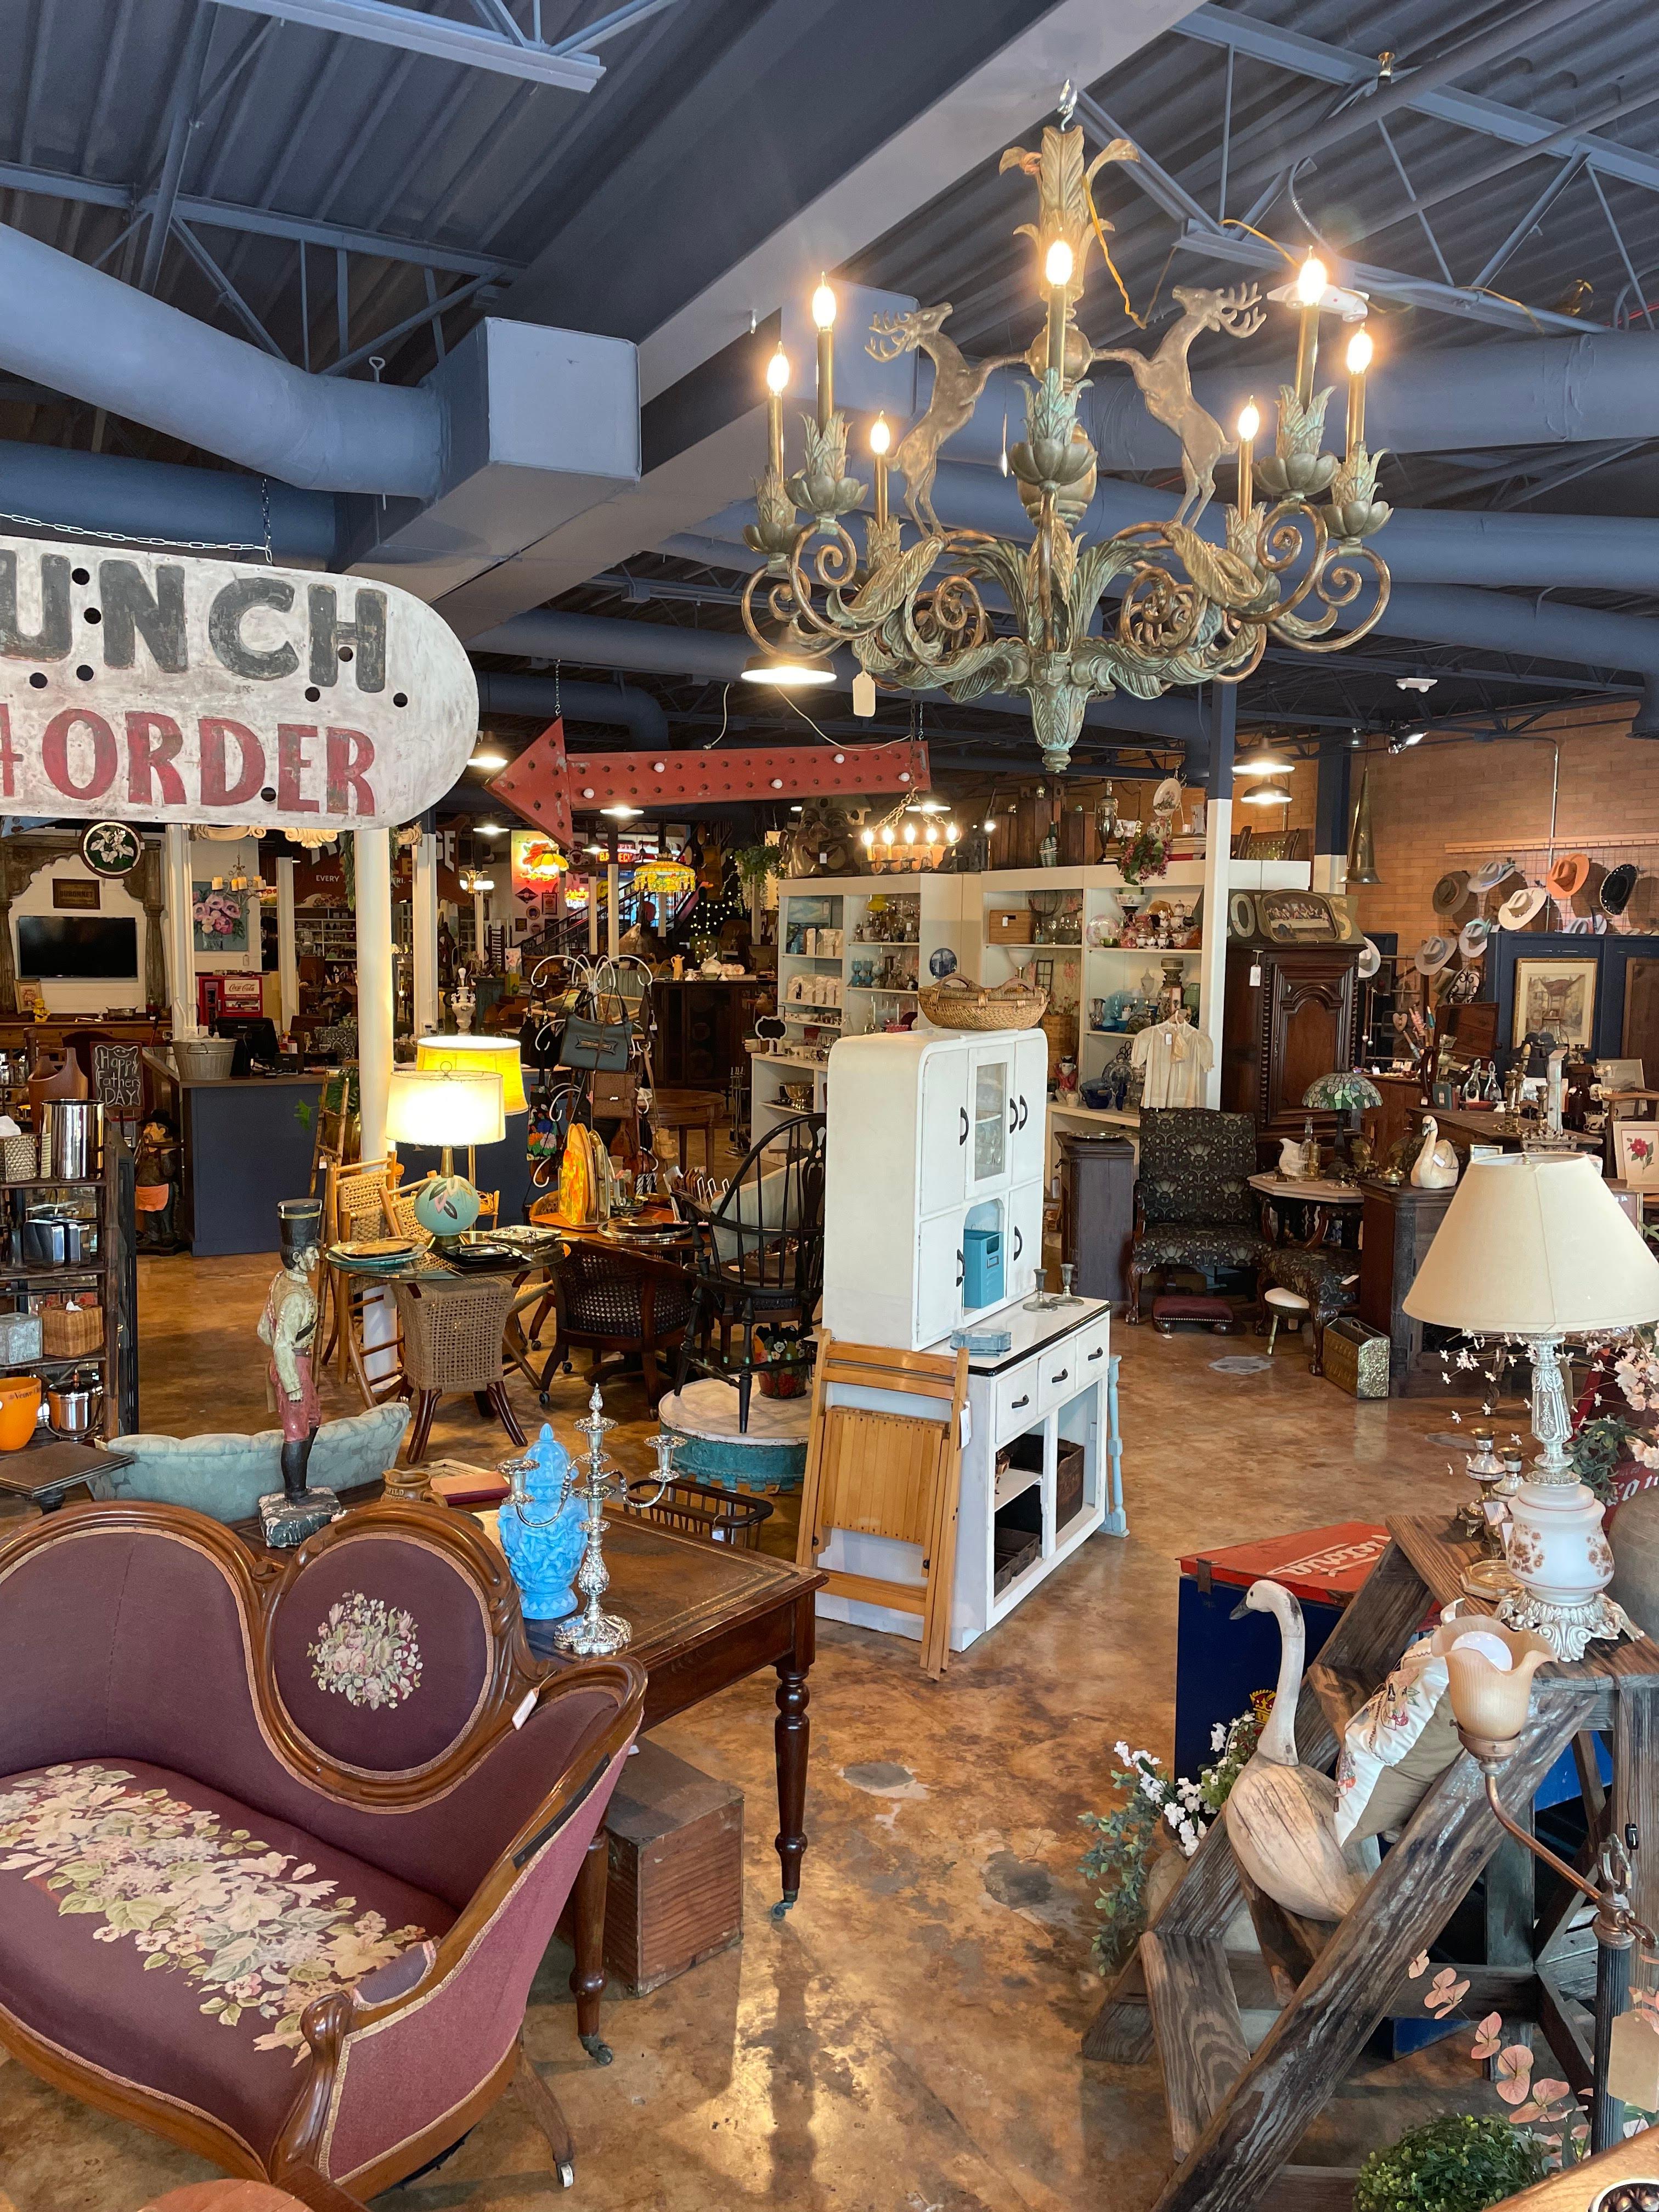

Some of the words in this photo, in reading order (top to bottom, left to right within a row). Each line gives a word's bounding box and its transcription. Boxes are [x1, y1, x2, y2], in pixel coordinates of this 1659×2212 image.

[42, 708, 375, 816] ORDER
[100, 1048, 139, 1077] Happy
[105, 1088, 136, 1106] DAY
